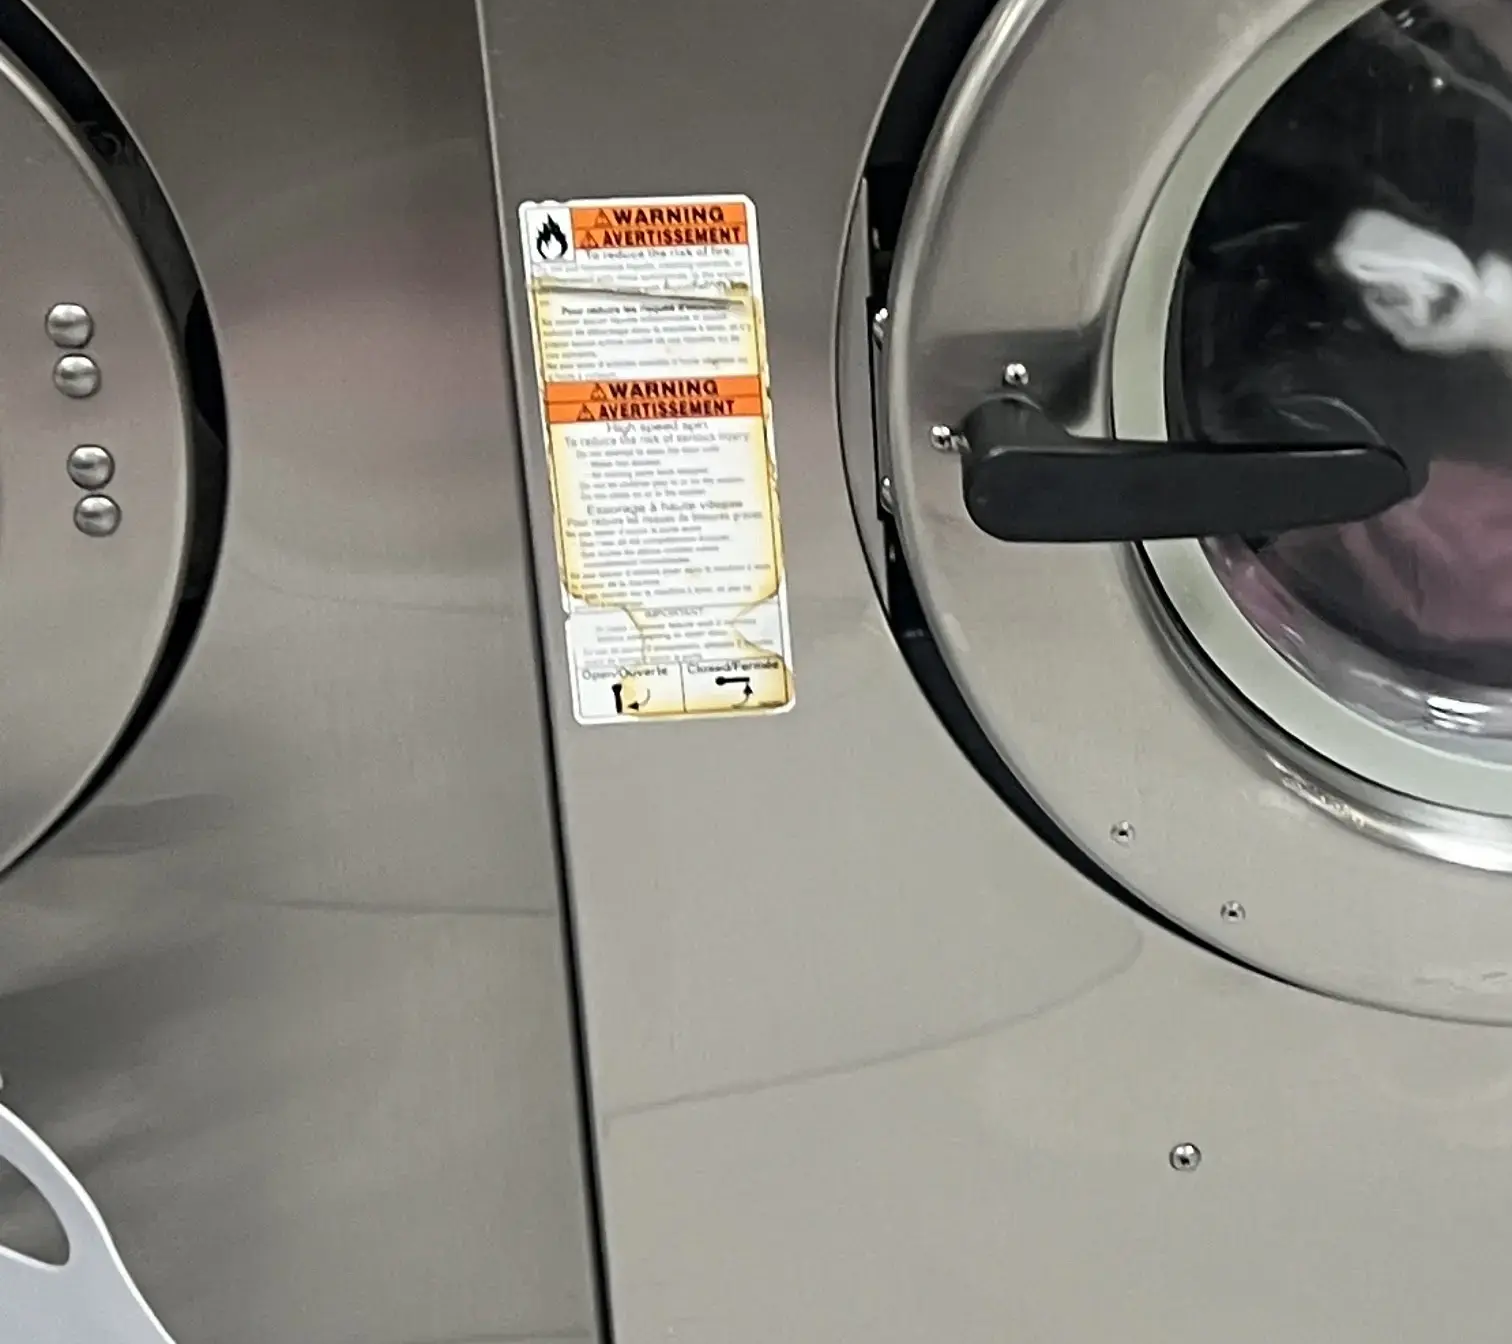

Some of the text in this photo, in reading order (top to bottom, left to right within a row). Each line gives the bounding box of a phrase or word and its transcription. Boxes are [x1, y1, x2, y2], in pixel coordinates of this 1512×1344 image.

[612, 206, 724, 225] WARNING
[603, 226, 741, 247] AVERTISSEMENT
[609, 380, 718, 399] WARNING
[600, 400, 735, 420] AVERTISSEMENT
